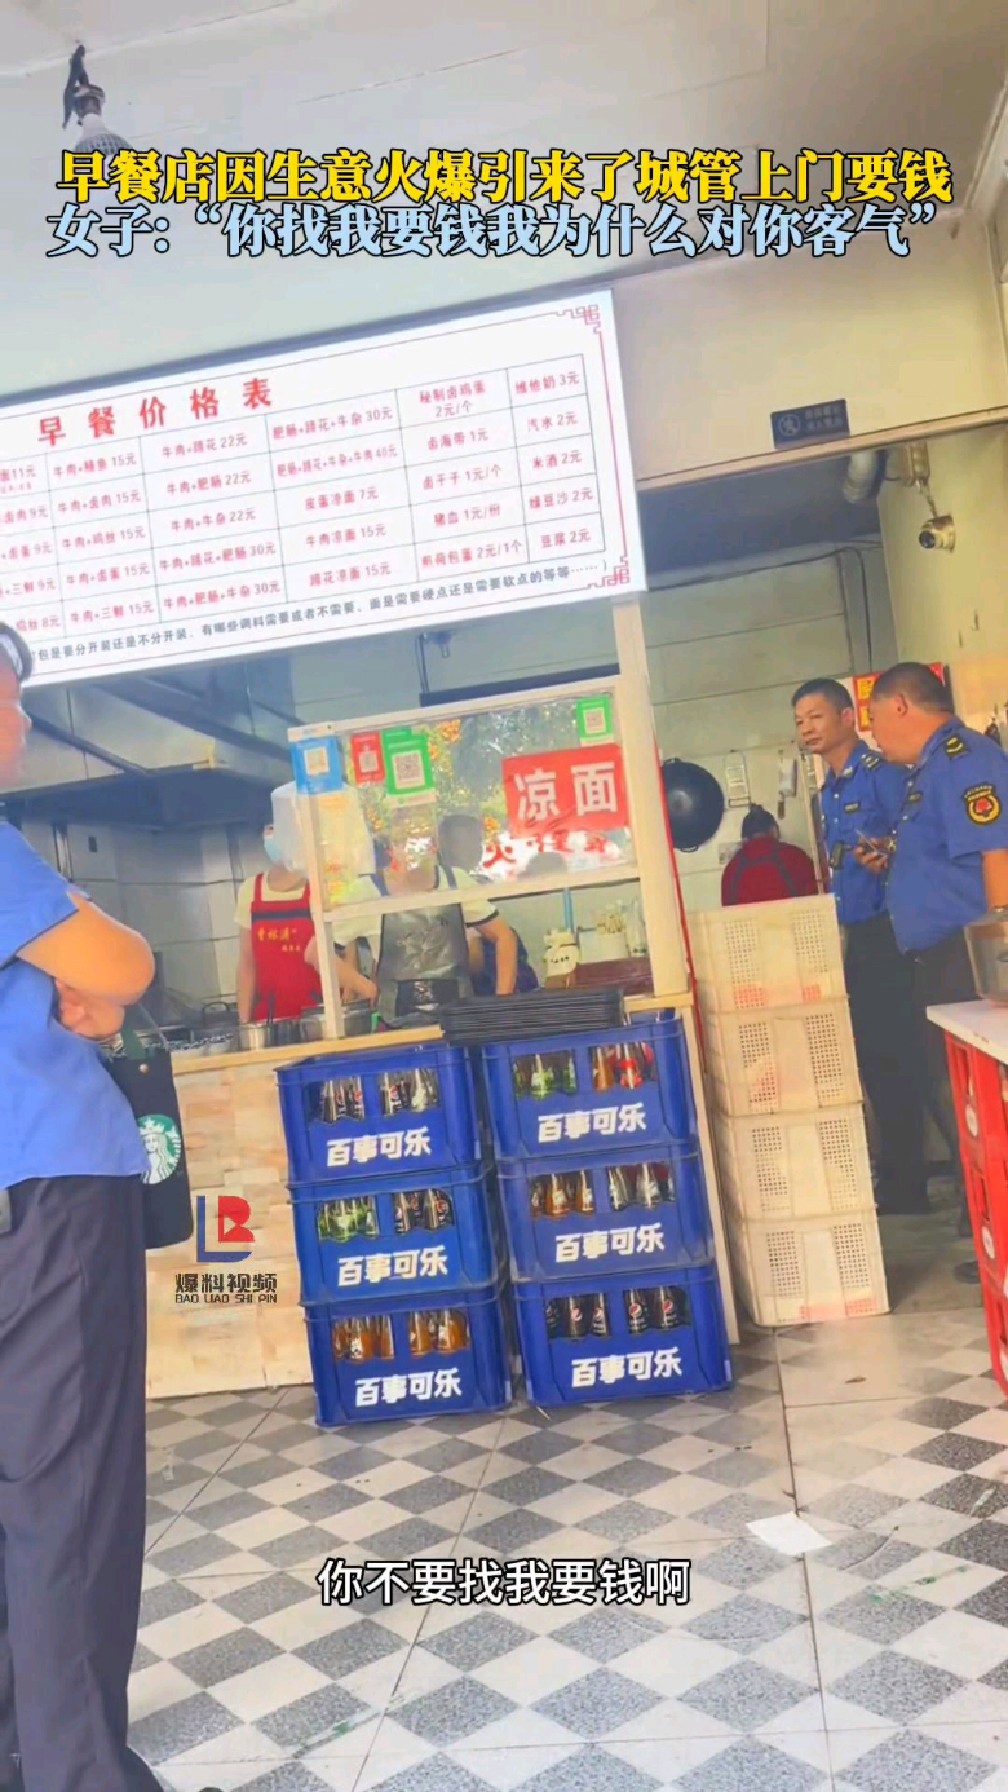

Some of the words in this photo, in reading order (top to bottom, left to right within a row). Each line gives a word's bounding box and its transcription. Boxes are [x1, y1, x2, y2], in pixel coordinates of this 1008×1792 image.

[560, 371, 580, 386] 3元
[38, 377, 273, 447] 早餐价格表
[366, 407, 394, 421] 30元
[436, 400, 474, 417] 2元/个
[528, 414, 554, 432] 汽水
[557, 411, 579, 426] 2元
[220, 433, 248, 448] 22元
[470, 428, 489, 441] 1元
[112, 453, 137, 466] 15元
[532, 453, 559, 469] 米酒
[561, 449, 583, 465] 2元
[225, 471, 252, 486] 22元
[116, 489, 141, 504] 15元
[359, 486, 379, 500] 7元
[571, 487, 593, 502] 2元
[229, 508, 256, 521] 22元
[120, 526, 146, 539] 15元
[361, 523, 386, 537] 15元
[570, 528, 592, 542] 2元
[251, 542, 277, 557] 30元
[125, 562, 150, 576] 15元
[365, 562, 392, 576] 15元
[254, 581, 280, 595] 30元
[129, 600, 154, 614] 15元
[514, 761, 619, 822] 凉面
[537, 1103, 646, 1143] 百事可乐
[326, 1127, 431, 1167] 百事可乐
[555, 1223, 665, 1263] 百事可乐
[338, 1246, 448, 1286] 百事可乐
[571, 1348, 682, 1387] 百事可乐
[354, 1368, 463, 1407] 百事可乐
